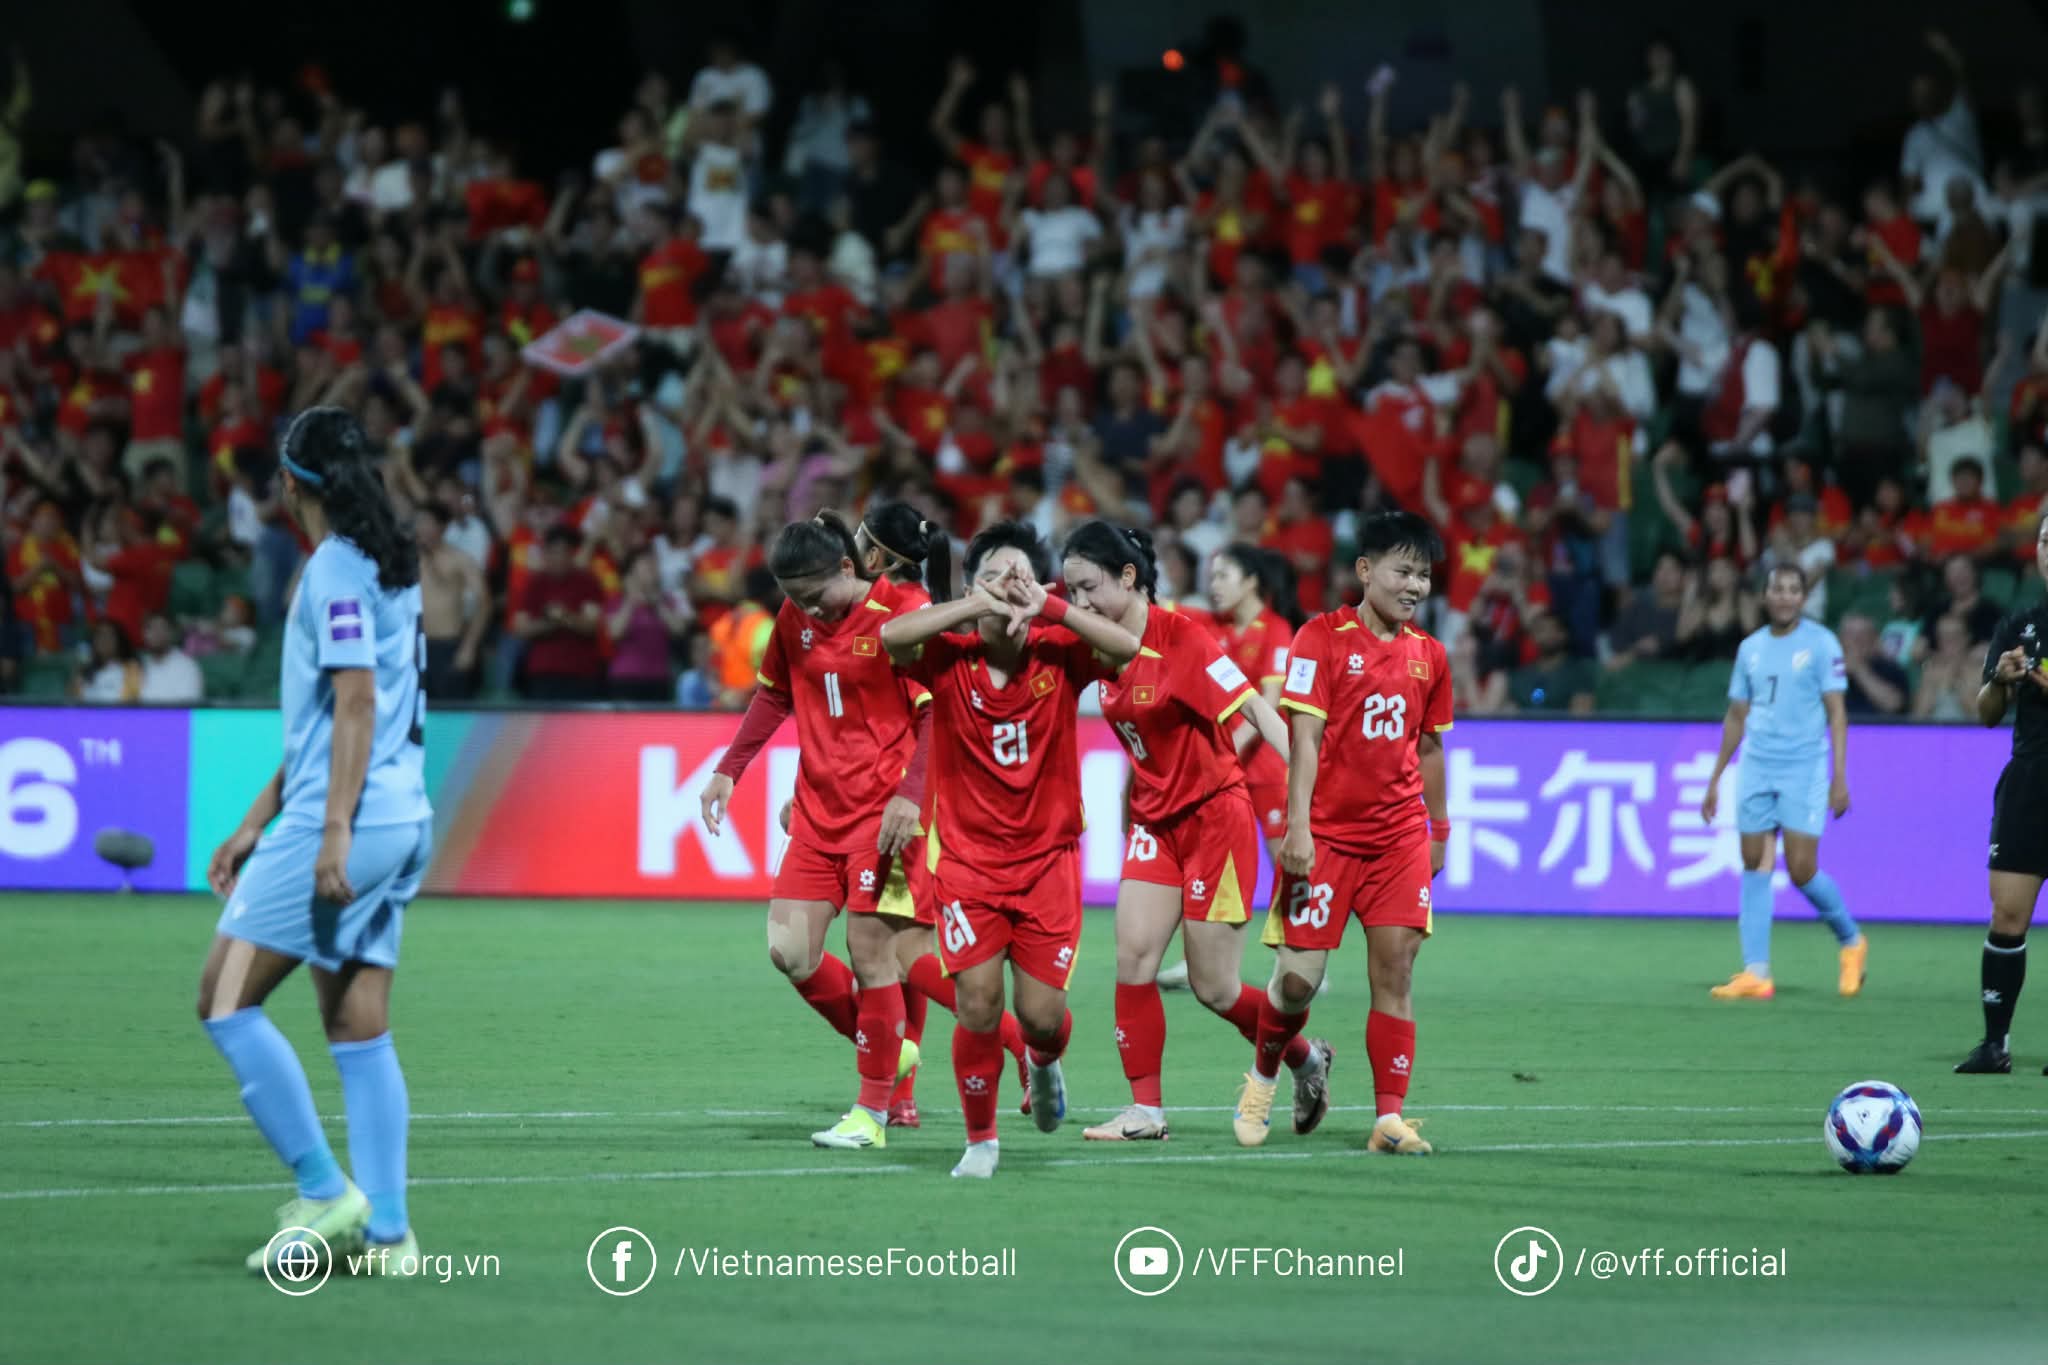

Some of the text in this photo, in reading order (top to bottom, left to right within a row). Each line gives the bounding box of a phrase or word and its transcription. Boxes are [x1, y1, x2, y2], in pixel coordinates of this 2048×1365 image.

[824, 672, 844, 718] 11
[1767, 676, 1779, 703] 7
[1362, 693, 1406, 741] 23
[992, 719, 1029, 767] 21
[1127, 824, 1158, 862] 15
[943, 900, 977, 953] 21
[1289, 881, 1334, 929] 23
